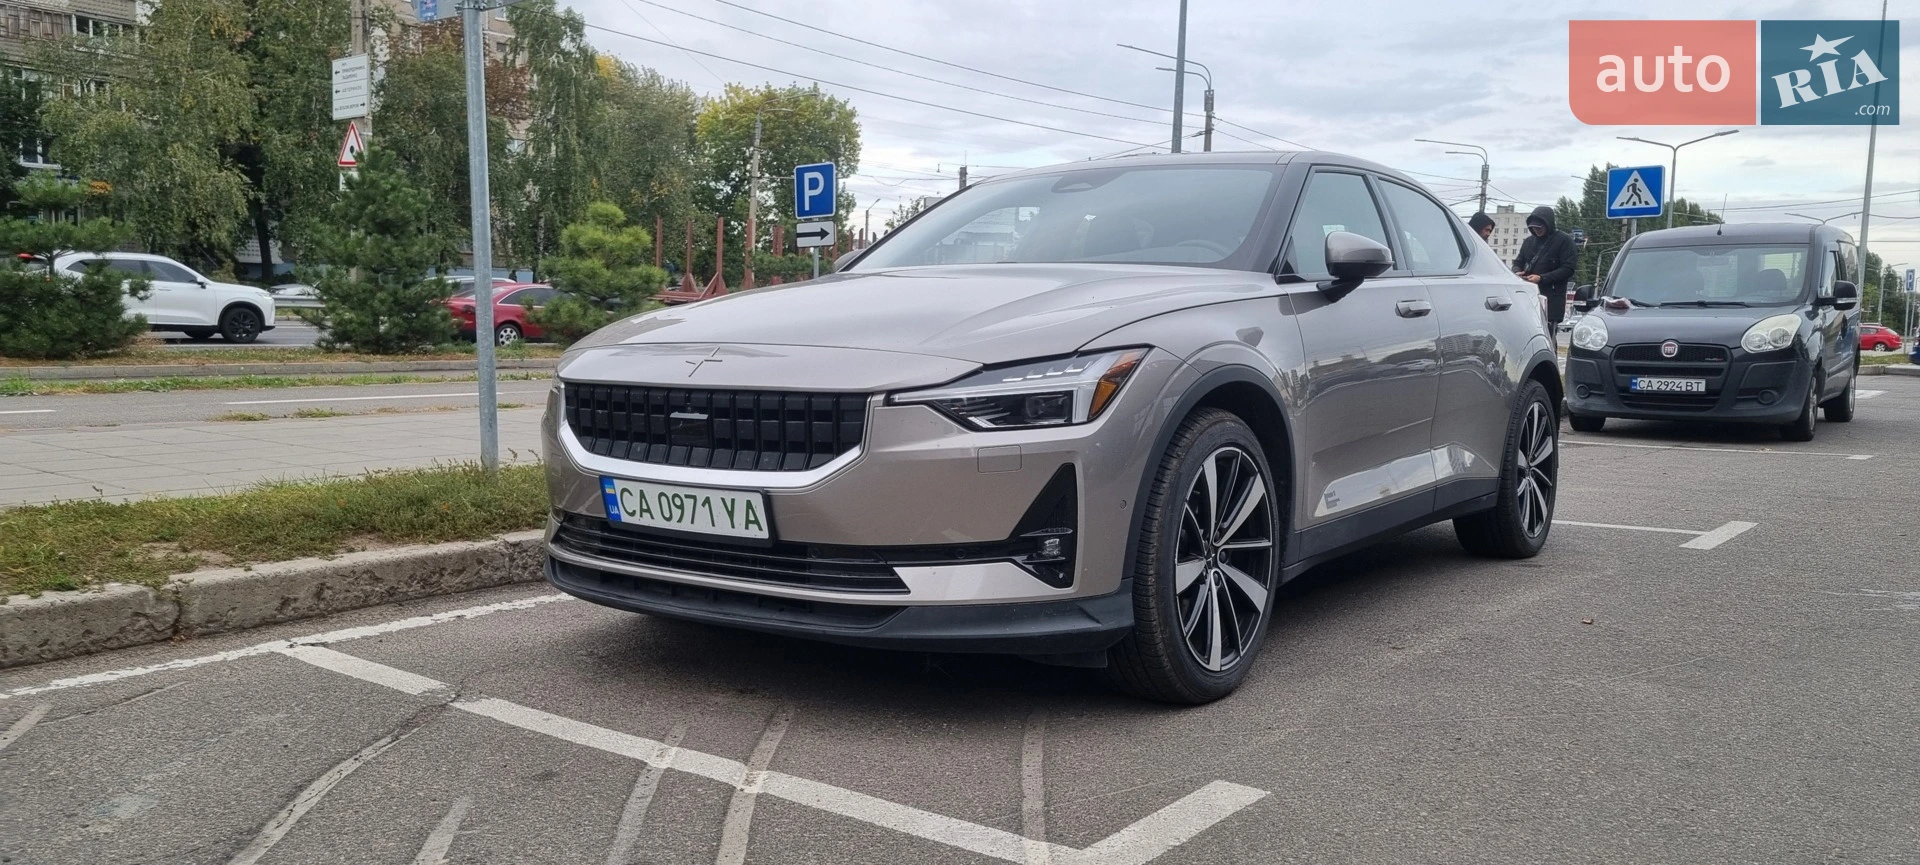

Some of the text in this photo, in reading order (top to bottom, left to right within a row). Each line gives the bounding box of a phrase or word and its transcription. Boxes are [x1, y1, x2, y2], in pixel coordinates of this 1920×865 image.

[804, 171, 825, 211] P
[1907, 272, 1913, 288] P
[1638, 379, 1703, 392] CA 2924 BT
[609, 505, 620, 515] UA
[619, 487, 763, 532] CA 0971 YA
